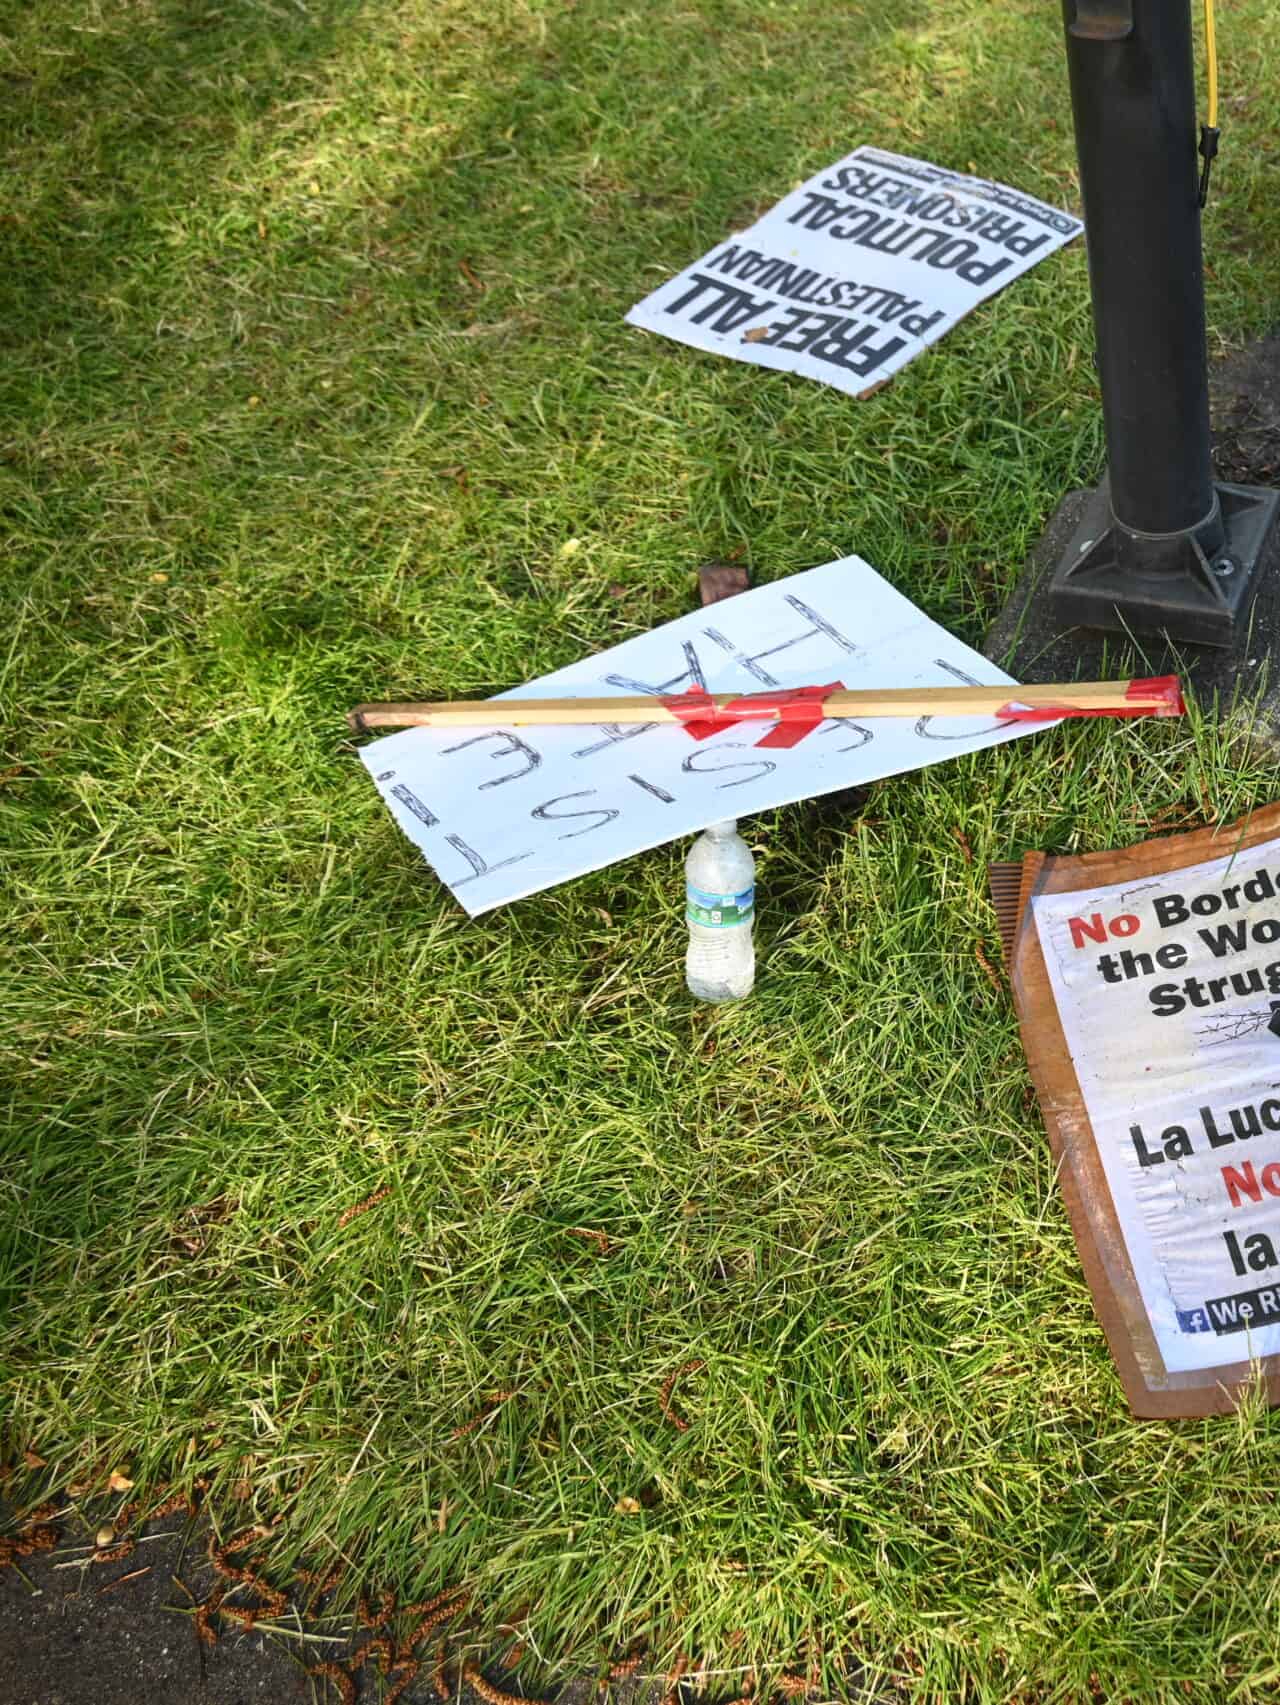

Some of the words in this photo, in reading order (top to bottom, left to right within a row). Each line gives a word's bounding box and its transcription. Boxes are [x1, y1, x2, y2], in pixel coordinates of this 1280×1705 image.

[786, 191, 1014, 287] POLITICAL
[822, 165, 1053, 258] PRISONERS
[663, 272, 776, 335] ALL
[704, 244, 947, 338] PALESTINIAN
[740, 306, 907, 378] FREE
[1068, 912, 1141, 949] No
[1097, 940, 1189, 984] the
[1130, 1121, 1193, 1168] La
[1223, 1228, 1280, 1277] la
[1213, 1298, 1254, 1325] We
